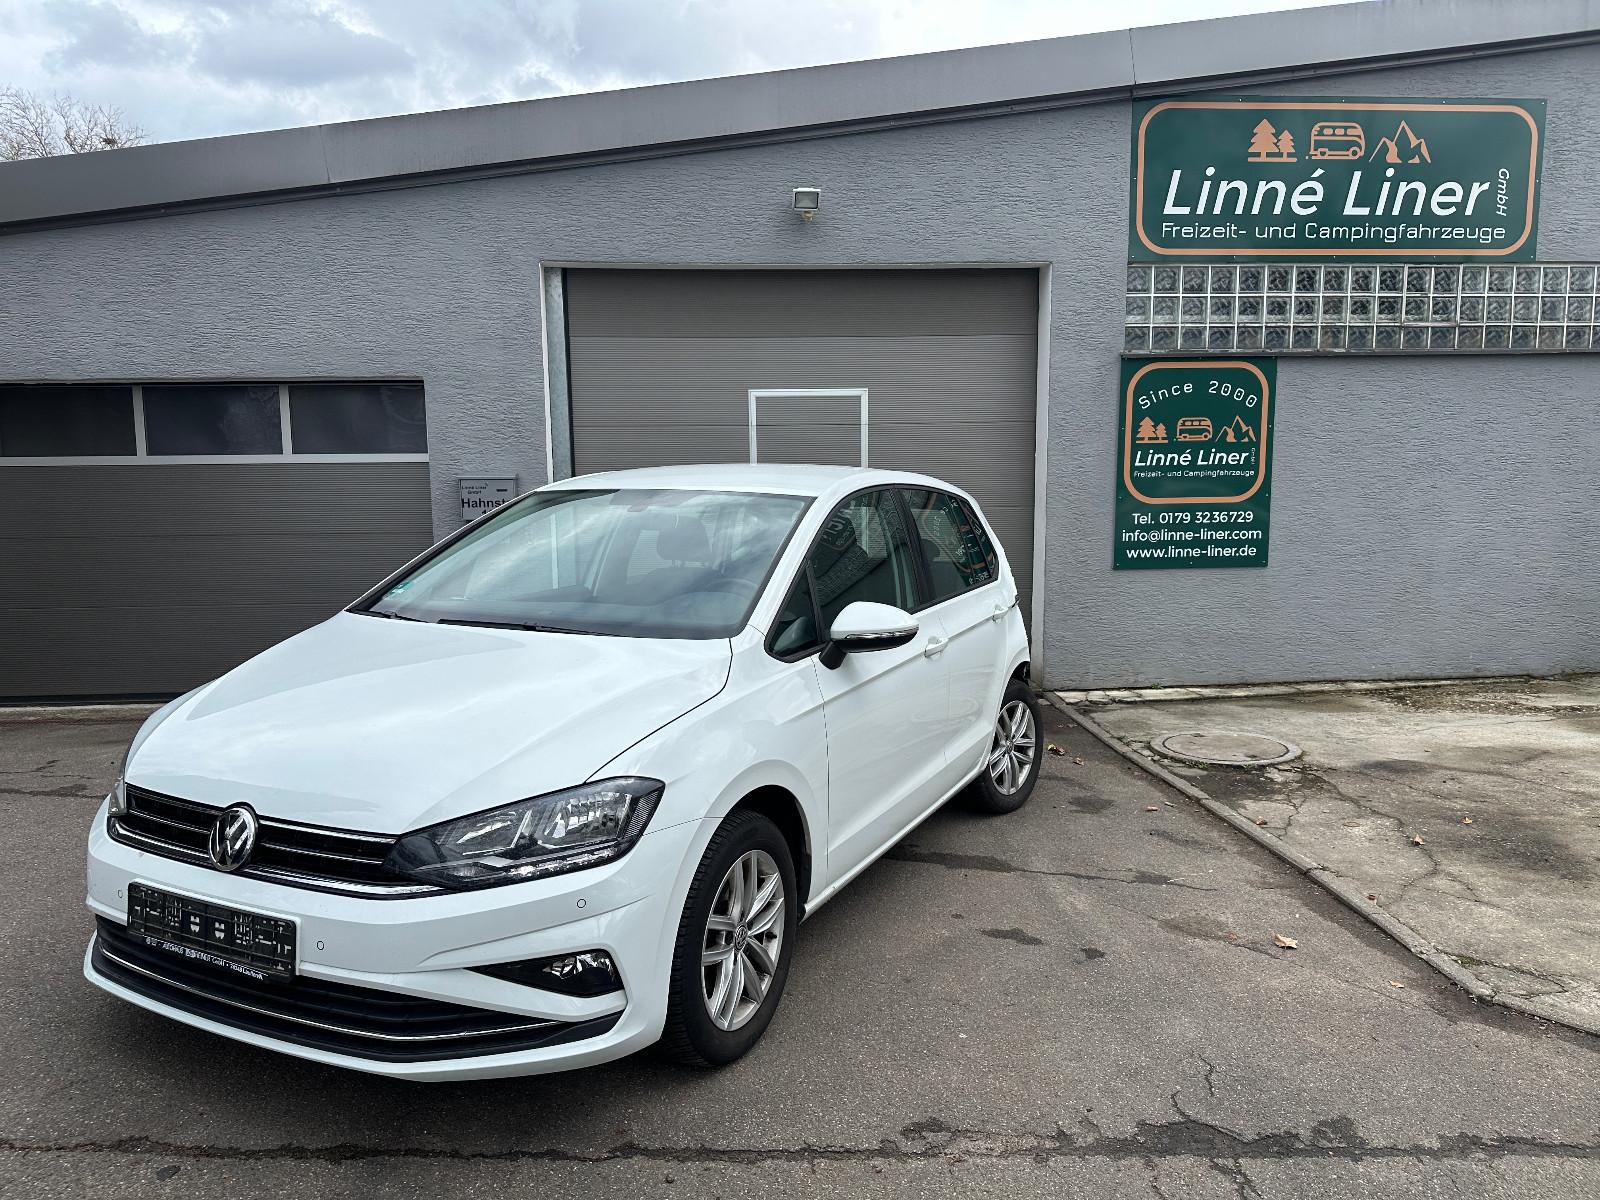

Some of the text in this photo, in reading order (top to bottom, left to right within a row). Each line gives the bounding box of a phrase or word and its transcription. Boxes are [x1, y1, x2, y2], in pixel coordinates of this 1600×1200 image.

[1163, 167, 1491, 216] Linné Liner
[1496, 168, 1510, 217] GmbH
[1162, 223, 1506, 244] Freizeit- und Campingfahrzeuge
[1138, 380, 1257, 409] Since 2000
[1134, 449, 1192, 467] Linné
[1197, 448, 1249, 466] Liner
[1133, 469, 1255, 479] Freizeit- und Campingfahrzeuge
[461, 498, 511, 509] Hahnst
[1132, 511, 1254, 525] Tel. 0179 3236729
[1122, 528, 1262, 542] info@linne-liner.com
[1126, 545, 1257, 558] www.linne-liner.de
